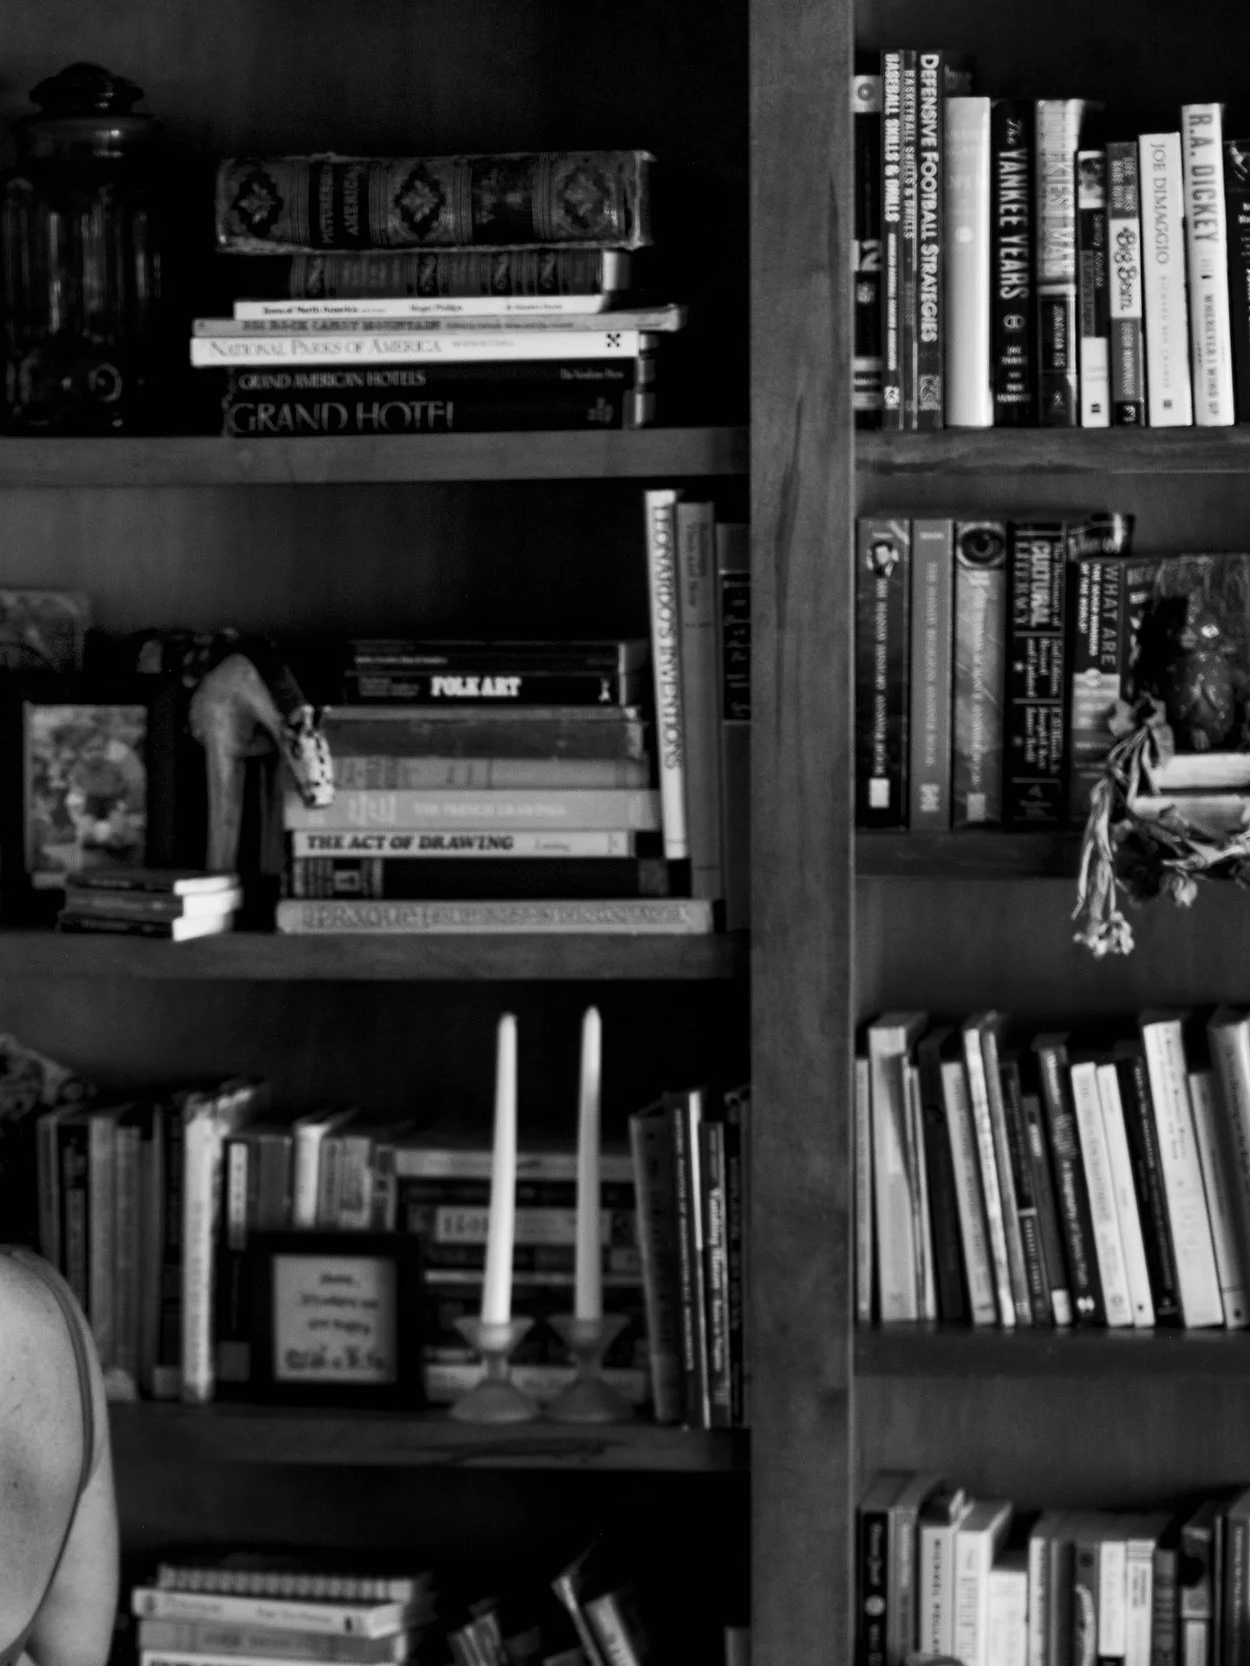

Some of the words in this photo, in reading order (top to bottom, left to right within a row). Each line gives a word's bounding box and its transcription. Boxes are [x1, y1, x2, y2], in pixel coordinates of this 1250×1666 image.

[884, 53, 899, 116] BASEBALL
[921, 54, 938, 146] DEFENSIVE
[904, 70, 915, 143] BASKETBALL
[884, 118, 899, 161] SKILLS
[1006, 118, 1022, 144] The
[1189, 114, 1214, 157] R.A.
[884, 165, 899, 176] &
[904, 146, 916, 184] SKILLS
[1150, 144, 1166, 171] JOE
[884, 178, 899, 222] DRILLS
[921, 152, 938, 239] FOOTBALL
[999, 148, 1028, 226] YANKEE
[1192, 165, 1218, 242] DICKEY
[904, 200, 915, 239] DRILLS
[1092, 214, 1103, 246] Sandy
[1153, 177, 1169, 264] DIMAGGIO
[999, 234, 1029, 299] YEARS
[1050, 227, 1074, 273] MAN
[1114, 228, 1136, 263] Big
[1094, 252, 1105, 289] Koufax
[921, 244, 939, 342] STRATEGIES
[210, 341, 285, 357] NATIONAL
[291, 341, 340, 356] PARKS
[344, 341, 362, 355] OF
[369, 339, 441, 354] AMERICA
[232, 403, 346, 432] GRAND
[1014, 541, 1030, 625] LITERACY
[1031, 540, 1051, 628] CULTURAL
[1103, 567, 1118, 621] WHAT
[1101, 627, 1117, 666] ARE
[430, 676, 478, 697] FOLK
[479, 676, 522, 697] ART
[307, 836, 344, 850] THE
[349, 836, 384, 850] ACT
[389, 836, 412, 849] OF
[419, 836, 513, 850] DRAWING
